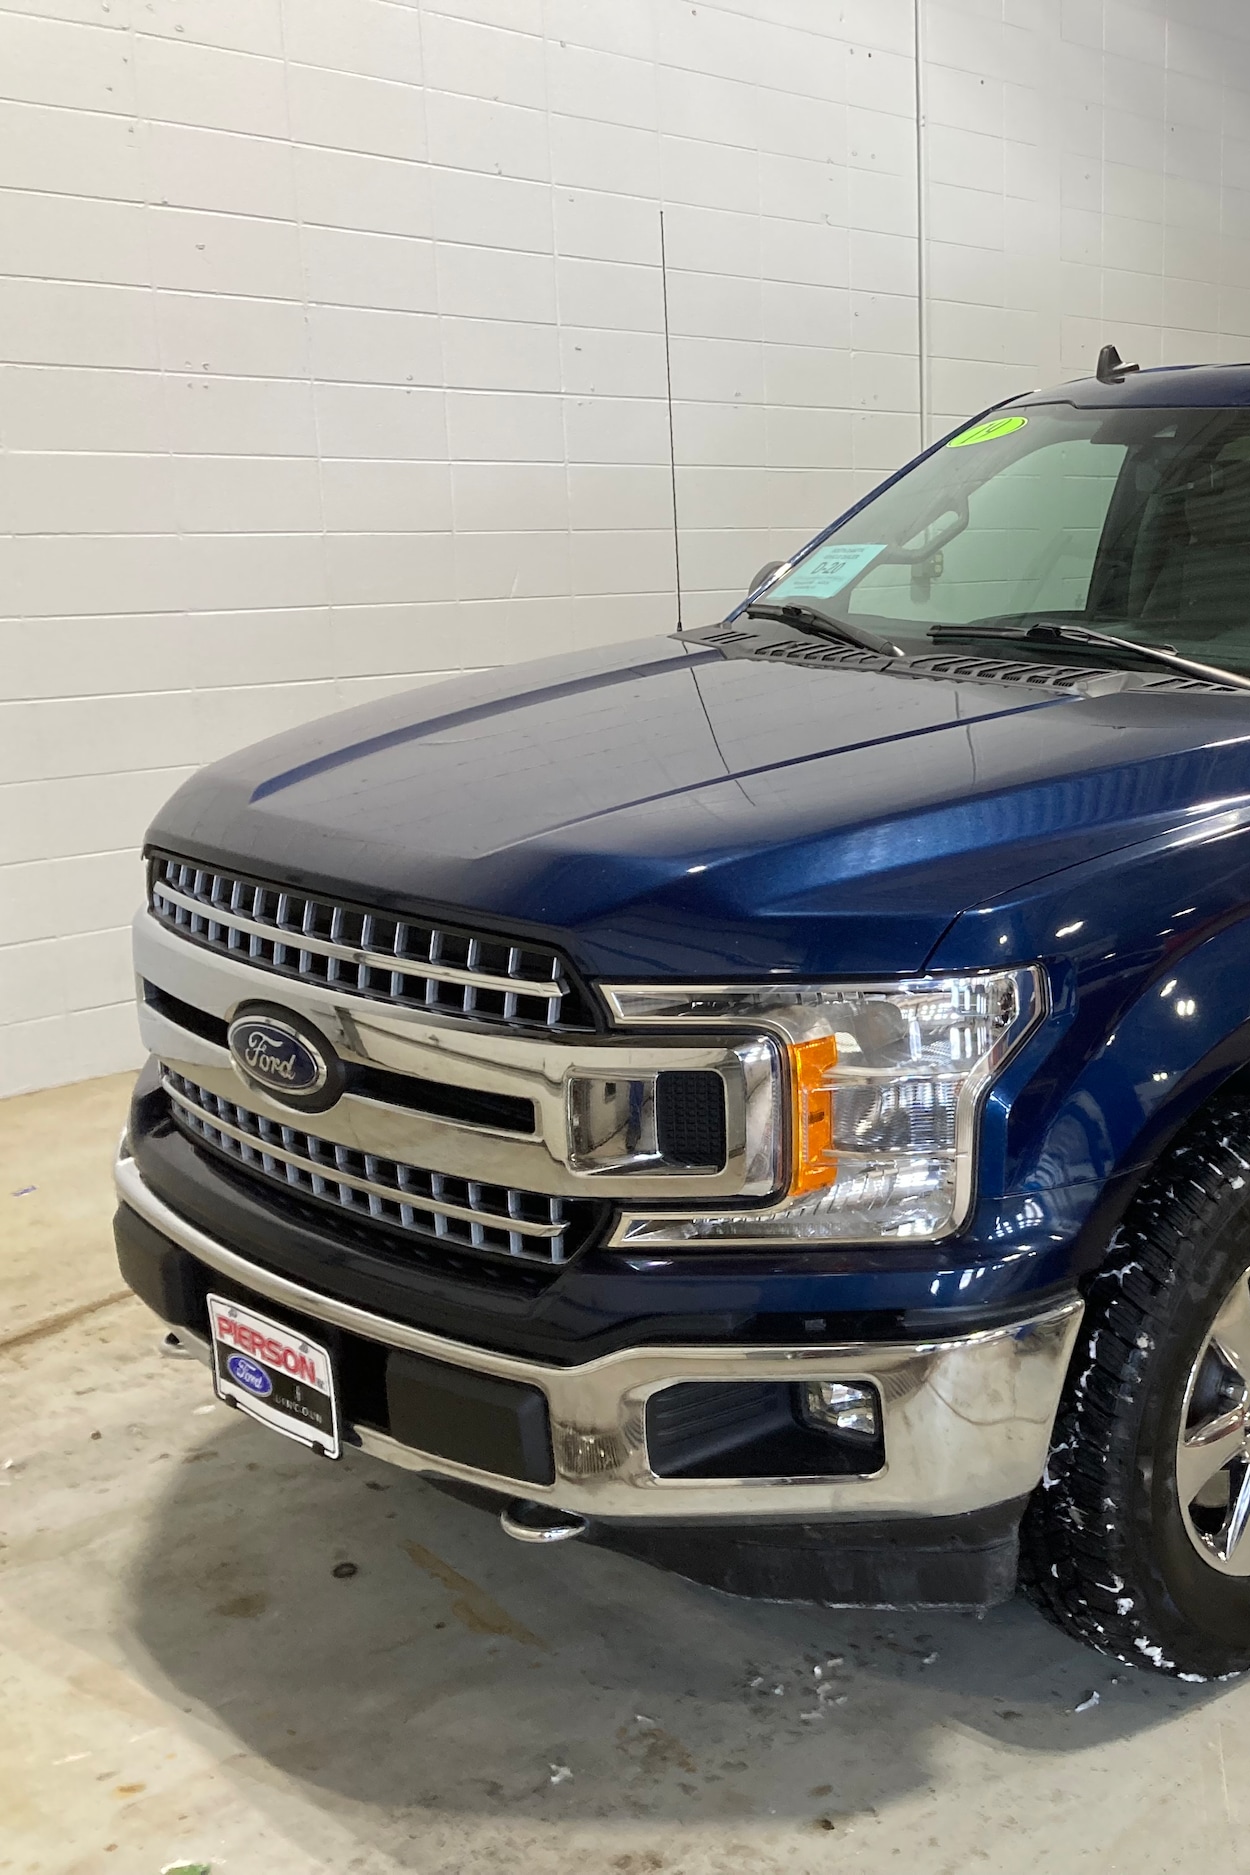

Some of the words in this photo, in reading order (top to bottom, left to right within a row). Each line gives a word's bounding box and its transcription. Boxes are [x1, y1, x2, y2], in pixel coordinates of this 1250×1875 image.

[245, 1031, 296, 1080] Ford
[216, 1315, 317, 1384] PIERSON
[235, 1359, 263, 1389] Ford
